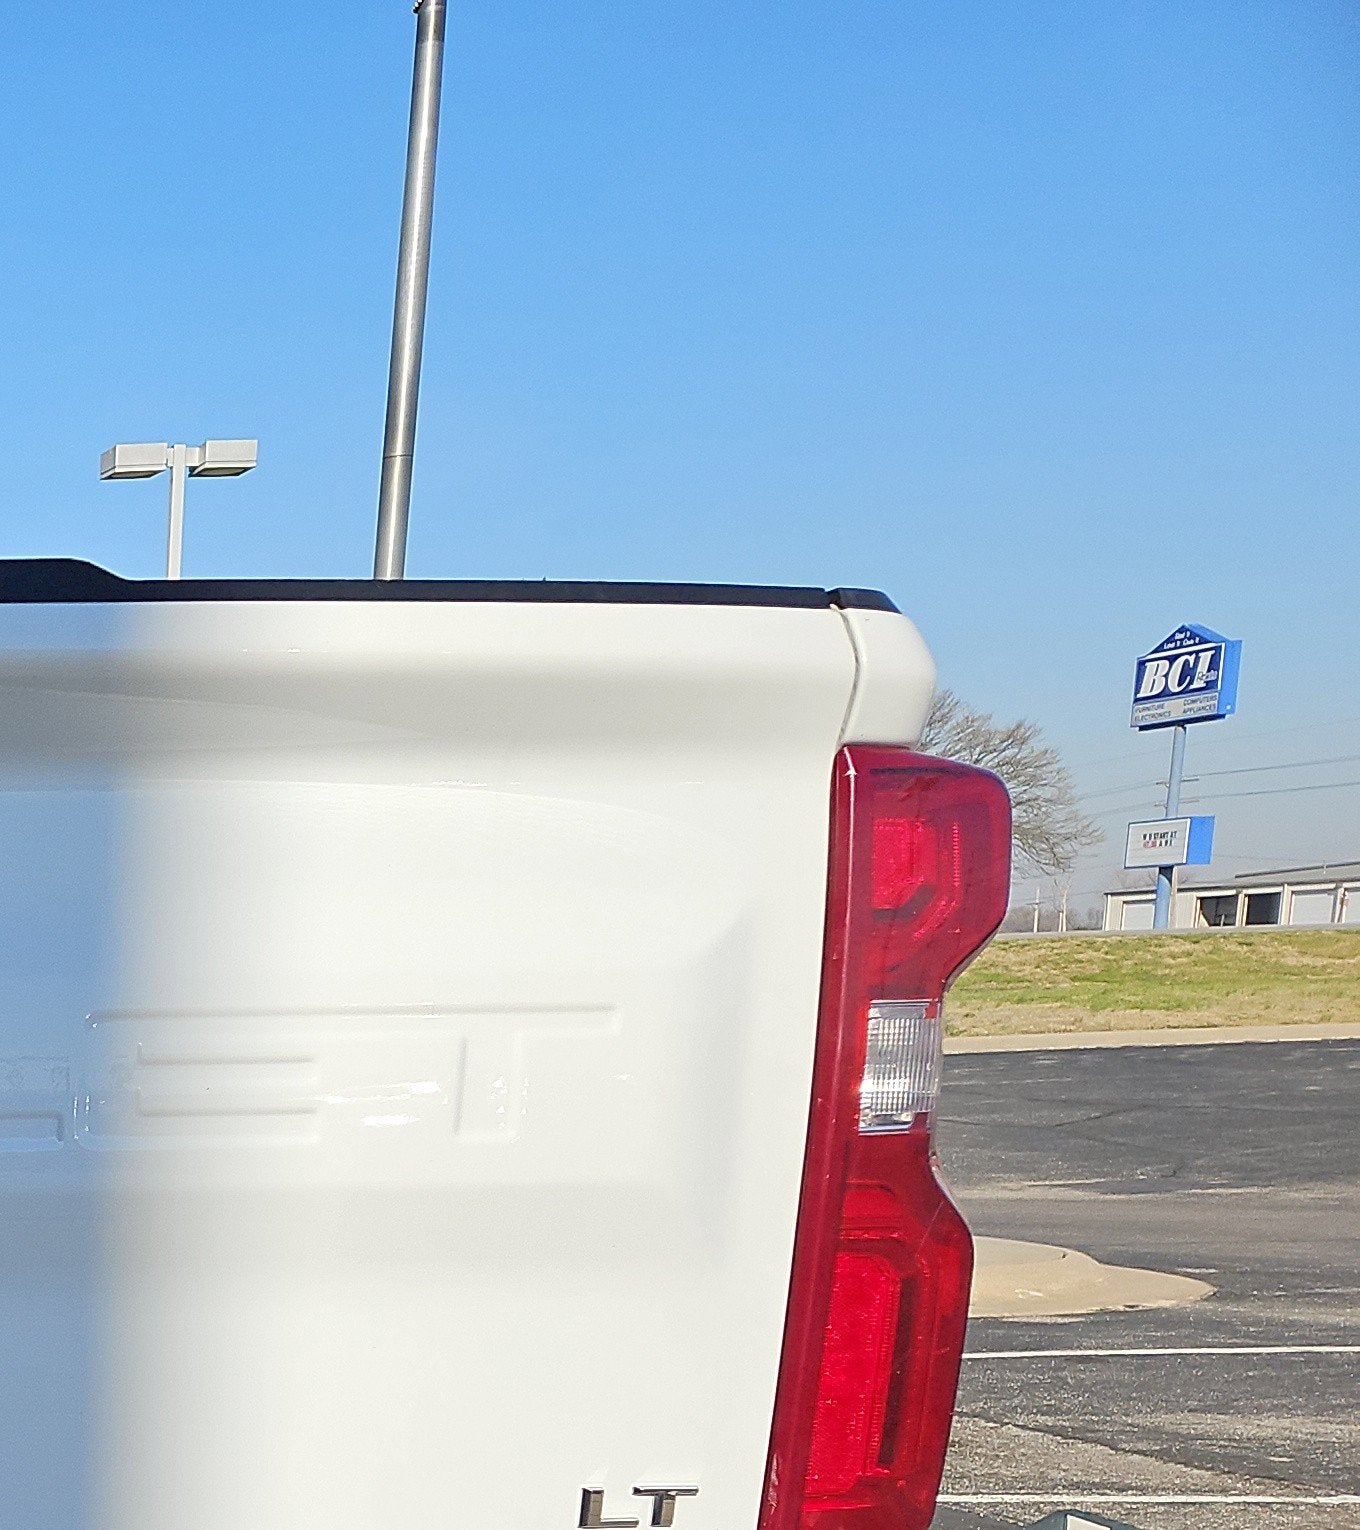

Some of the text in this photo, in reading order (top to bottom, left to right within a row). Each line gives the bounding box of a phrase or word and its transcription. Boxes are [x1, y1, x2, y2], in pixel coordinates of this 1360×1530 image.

[1134, 703, 1216, 721] ELECTRONICS APPLIANCES
[1135, 695, 1218, 714] FURNITURE COMPUTERS
[578, 1486, 699, 1529] LT
